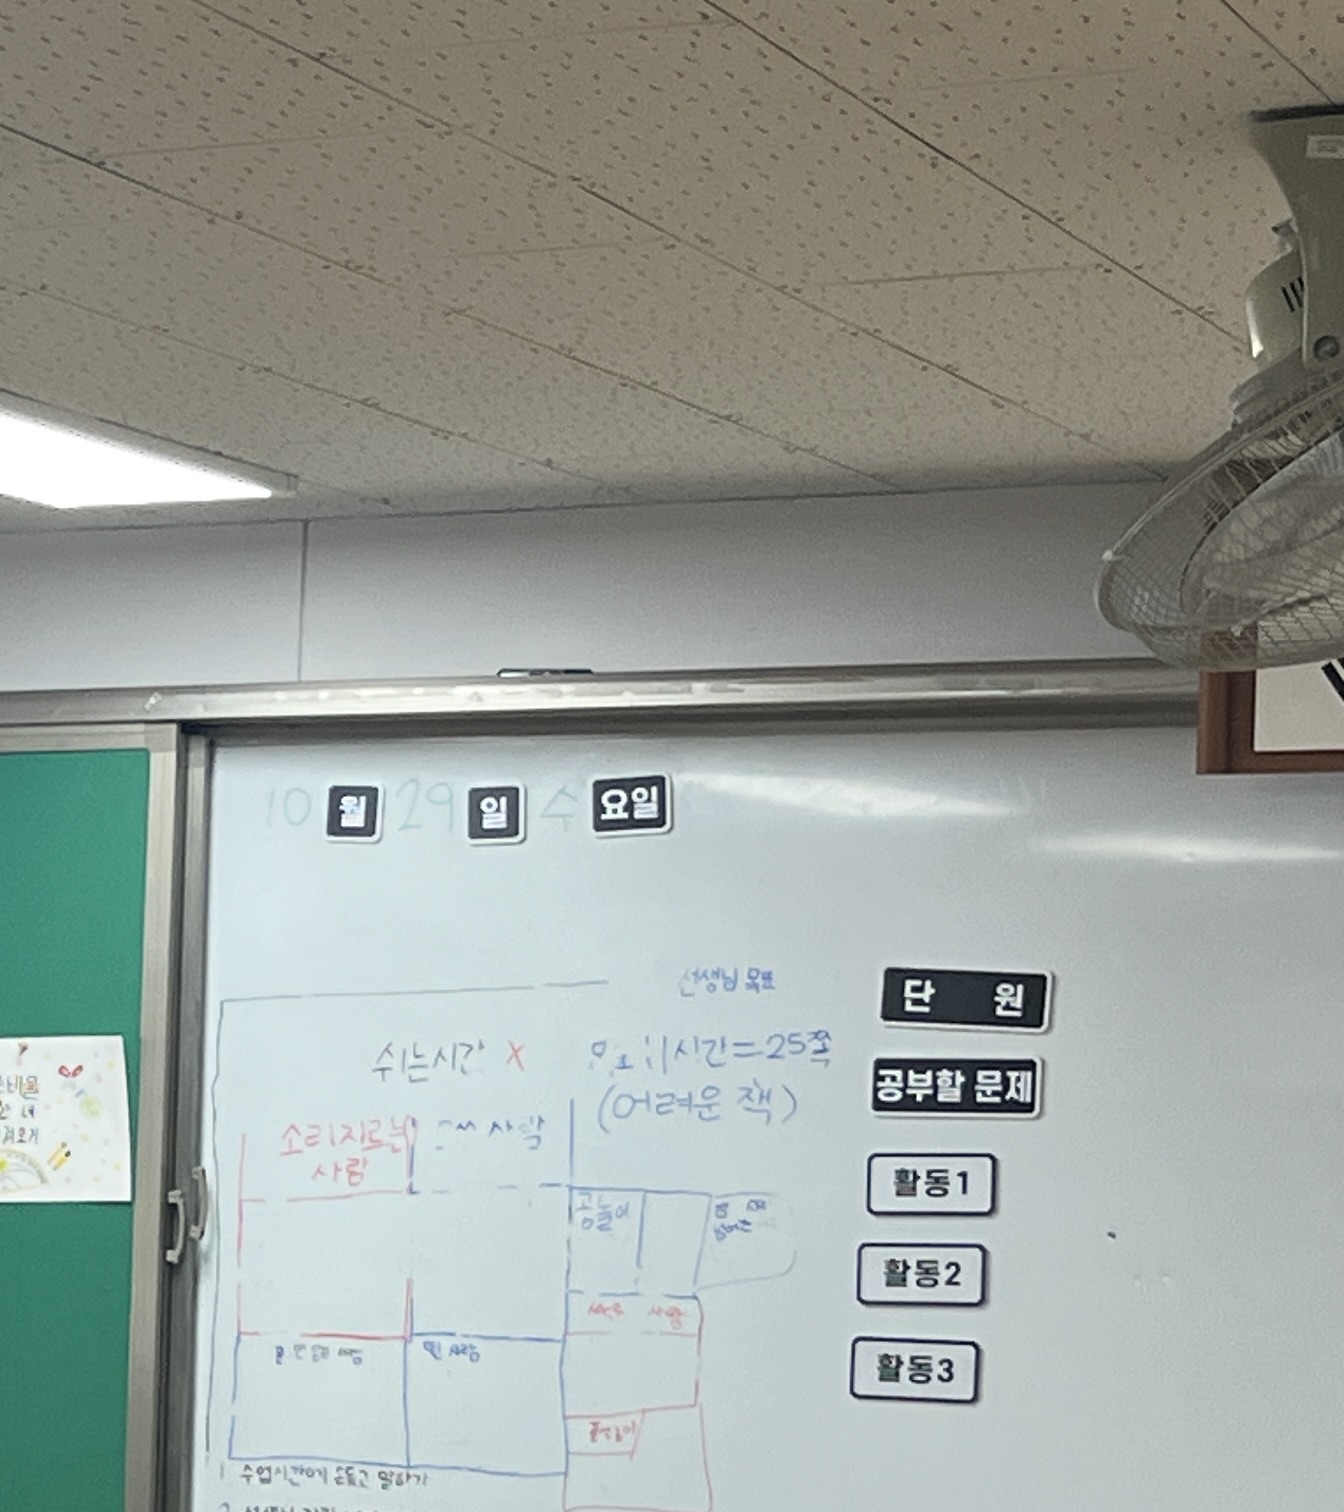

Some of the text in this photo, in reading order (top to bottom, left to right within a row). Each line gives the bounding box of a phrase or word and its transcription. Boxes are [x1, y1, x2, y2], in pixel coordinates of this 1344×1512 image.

[338, 795, 367, 828] 월
[395, 777, 456, 834] 29
[479, 796, 509, 830] 일
[599, 785, 660, 821] 요일
[876, 1068, 1033, 1104] 공부할 문제
